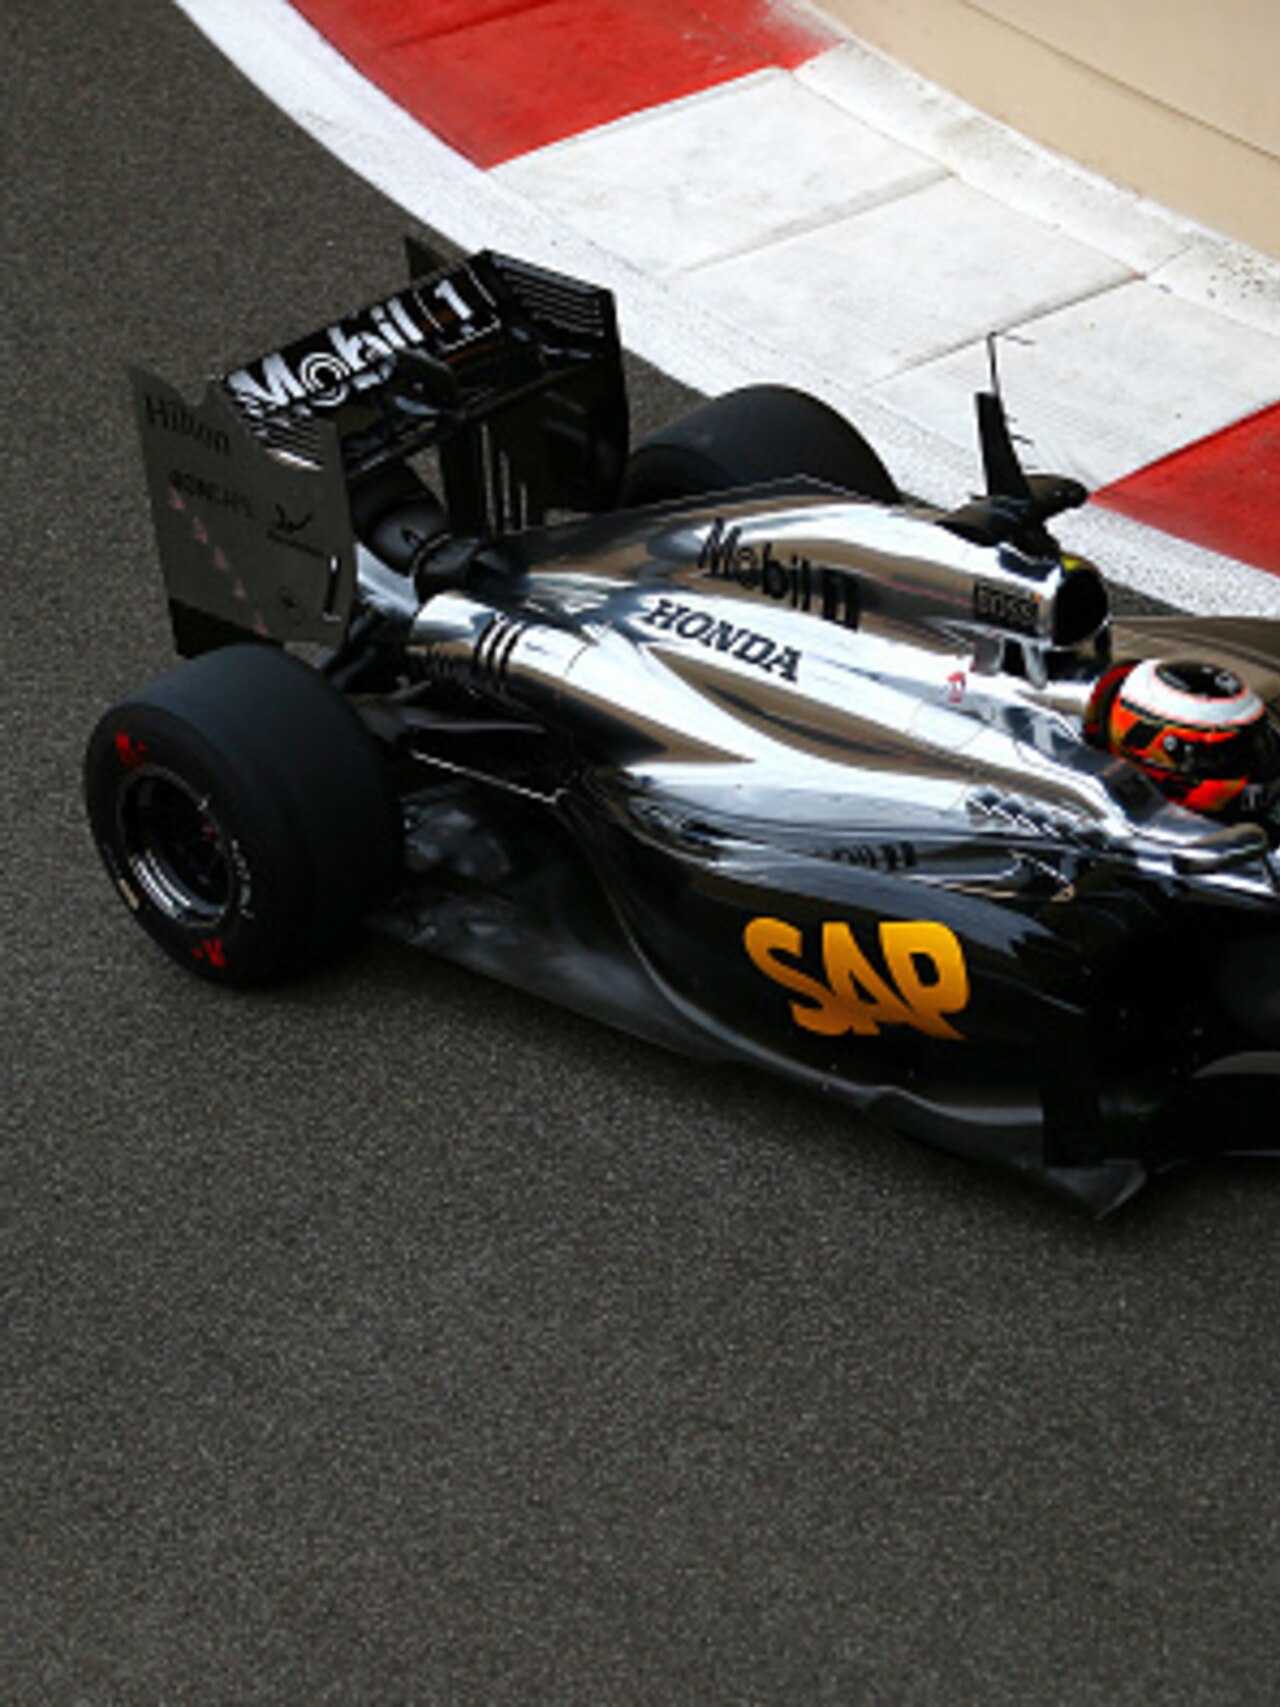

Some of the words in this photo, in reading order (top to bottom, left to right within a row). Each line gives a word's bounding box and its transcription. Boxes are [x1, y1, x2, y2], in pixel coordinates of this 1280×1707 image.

[226, 297, 425, 411] Mobil
[698, 517, 812, 612] Mobil
[641, 597, 803, 684] HONDA
[742, 916, 971, 1041] SAP
